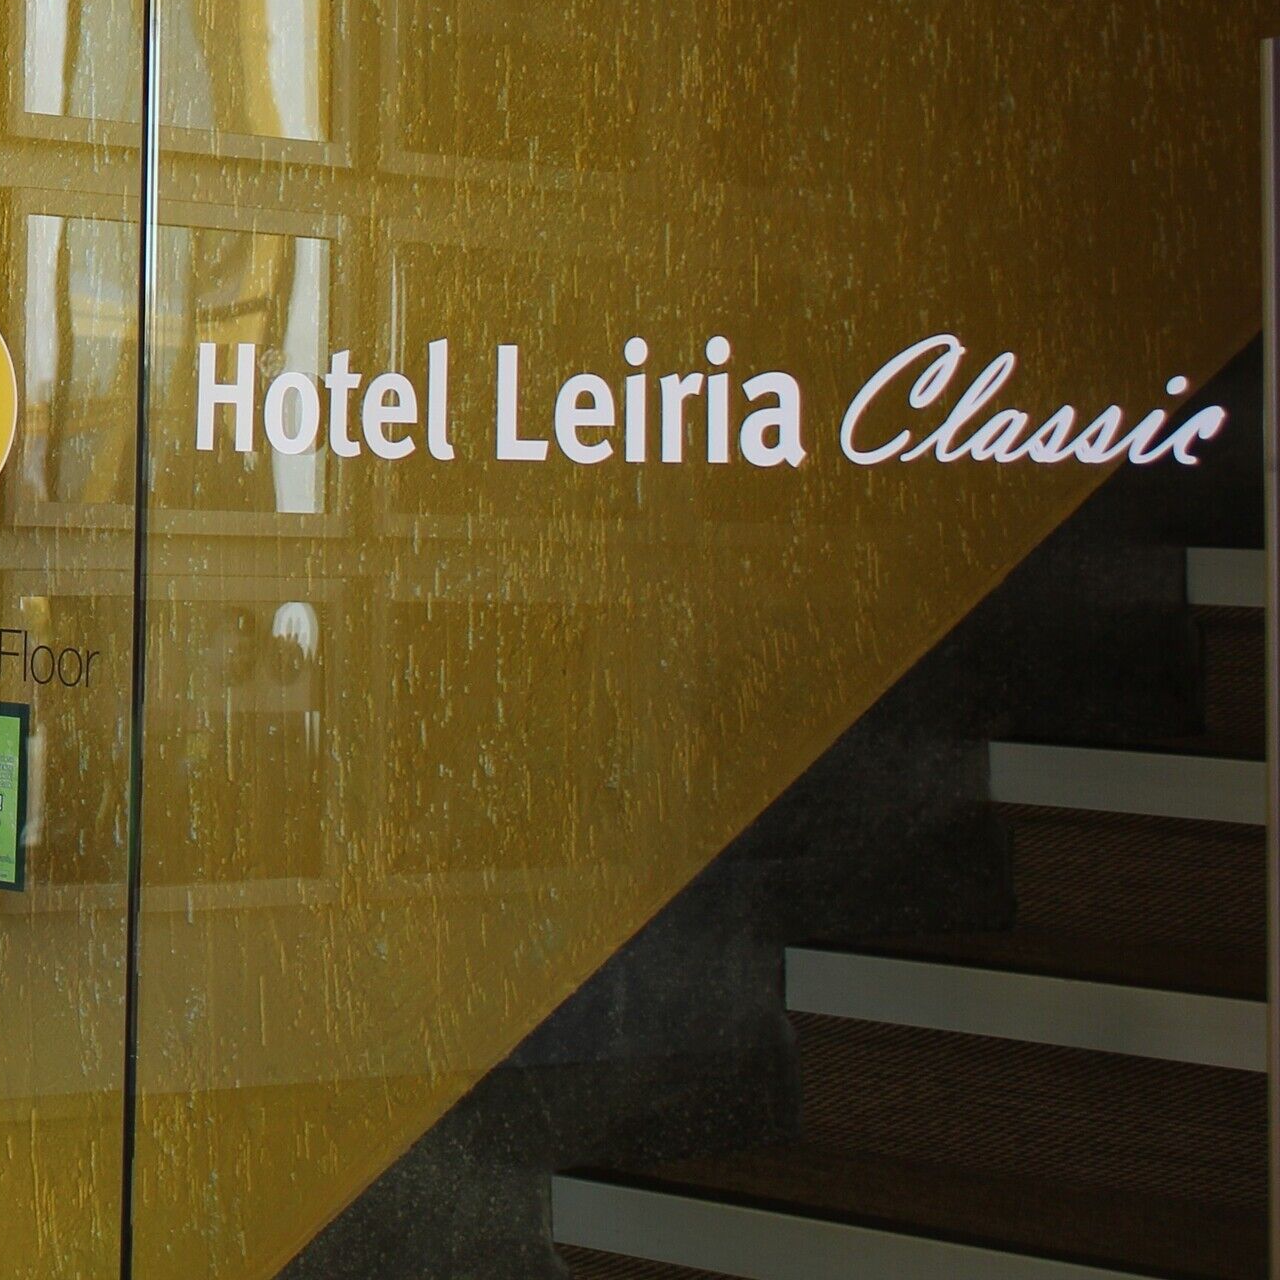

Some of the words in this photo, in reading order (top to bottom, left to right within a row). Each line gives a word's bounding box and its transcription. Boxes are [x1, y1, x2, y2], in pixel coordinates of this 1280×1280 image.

[194, 335, 456, 462] Hotel
[495, 334, 807, 467] Leiria
[839, 333, 1228, 466] Classic
